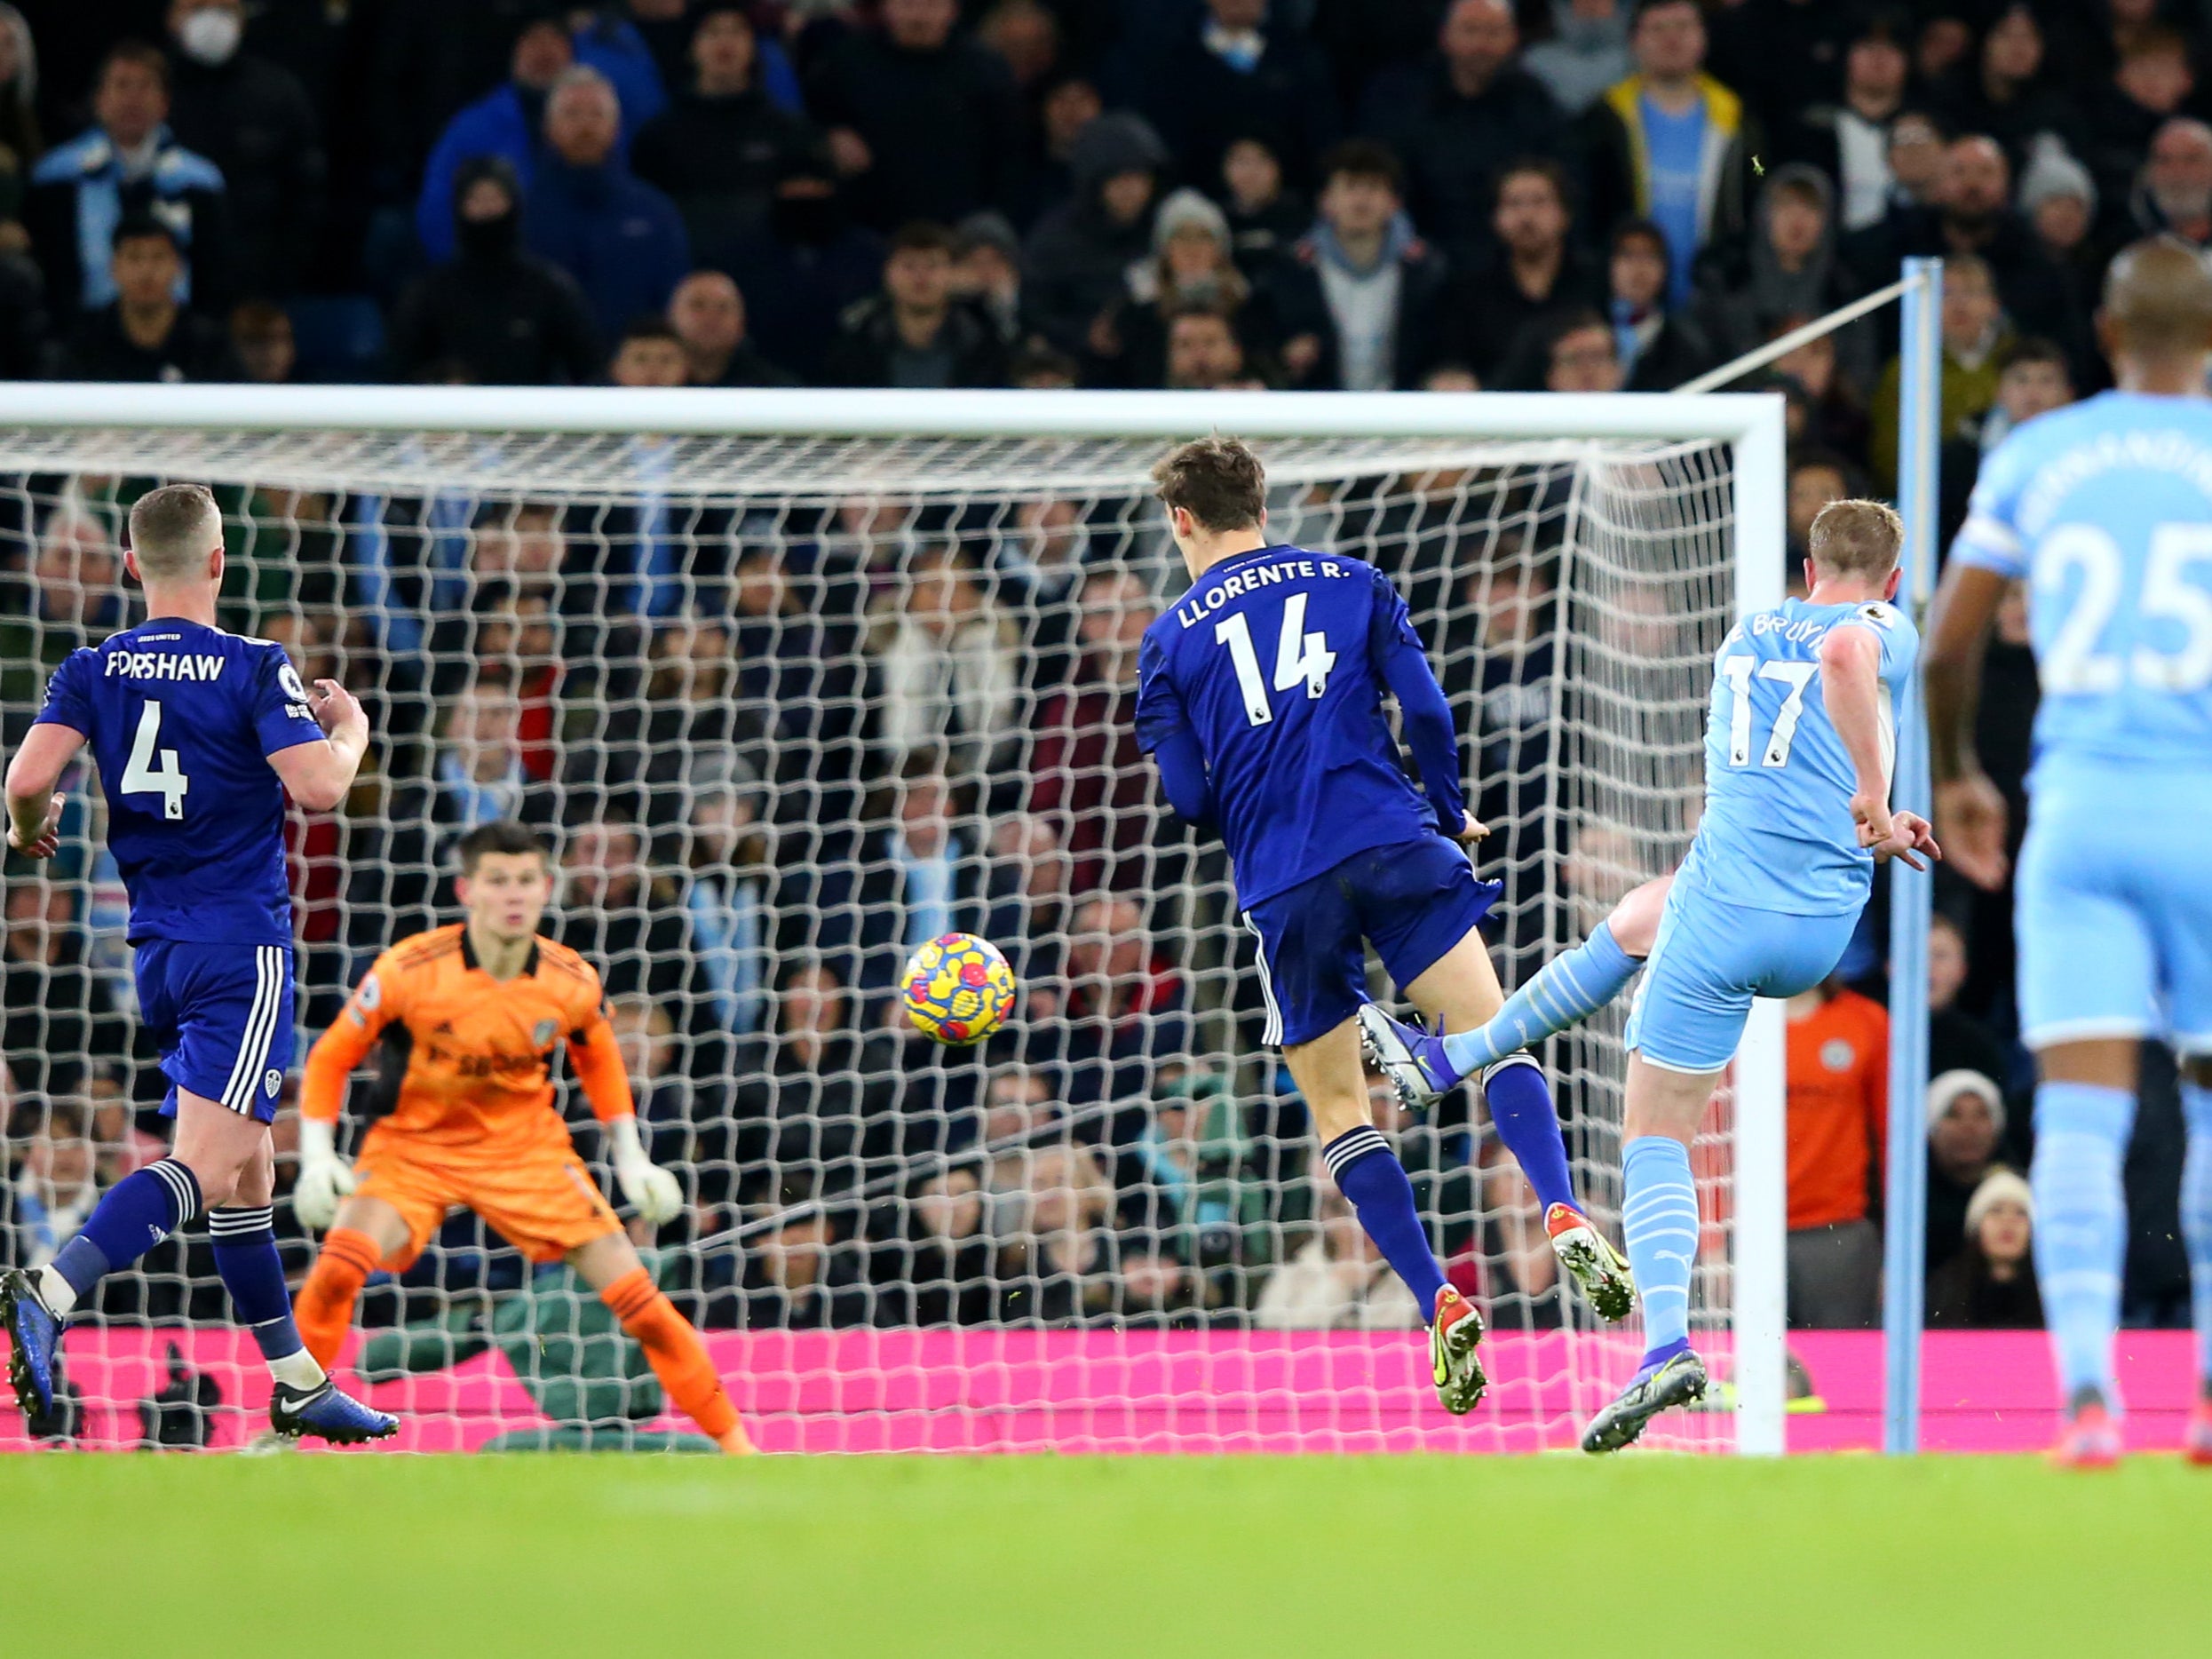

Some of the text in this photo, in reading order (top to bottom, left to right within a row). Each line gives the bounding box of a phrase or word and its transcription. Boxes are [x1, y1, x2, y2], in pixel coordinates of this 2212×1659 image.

[1177, 561, 1316, 630] LLORENTE
[1320, 561, 1351, 578] R.
[2032, 522, 2212, 691] 25
[104, 650, 225, 681] FORSHAW
[1215, 592, 1336, 726] 14
[1722, 655, 1820, 767] 17
[120, 699, 188, 820] 4
